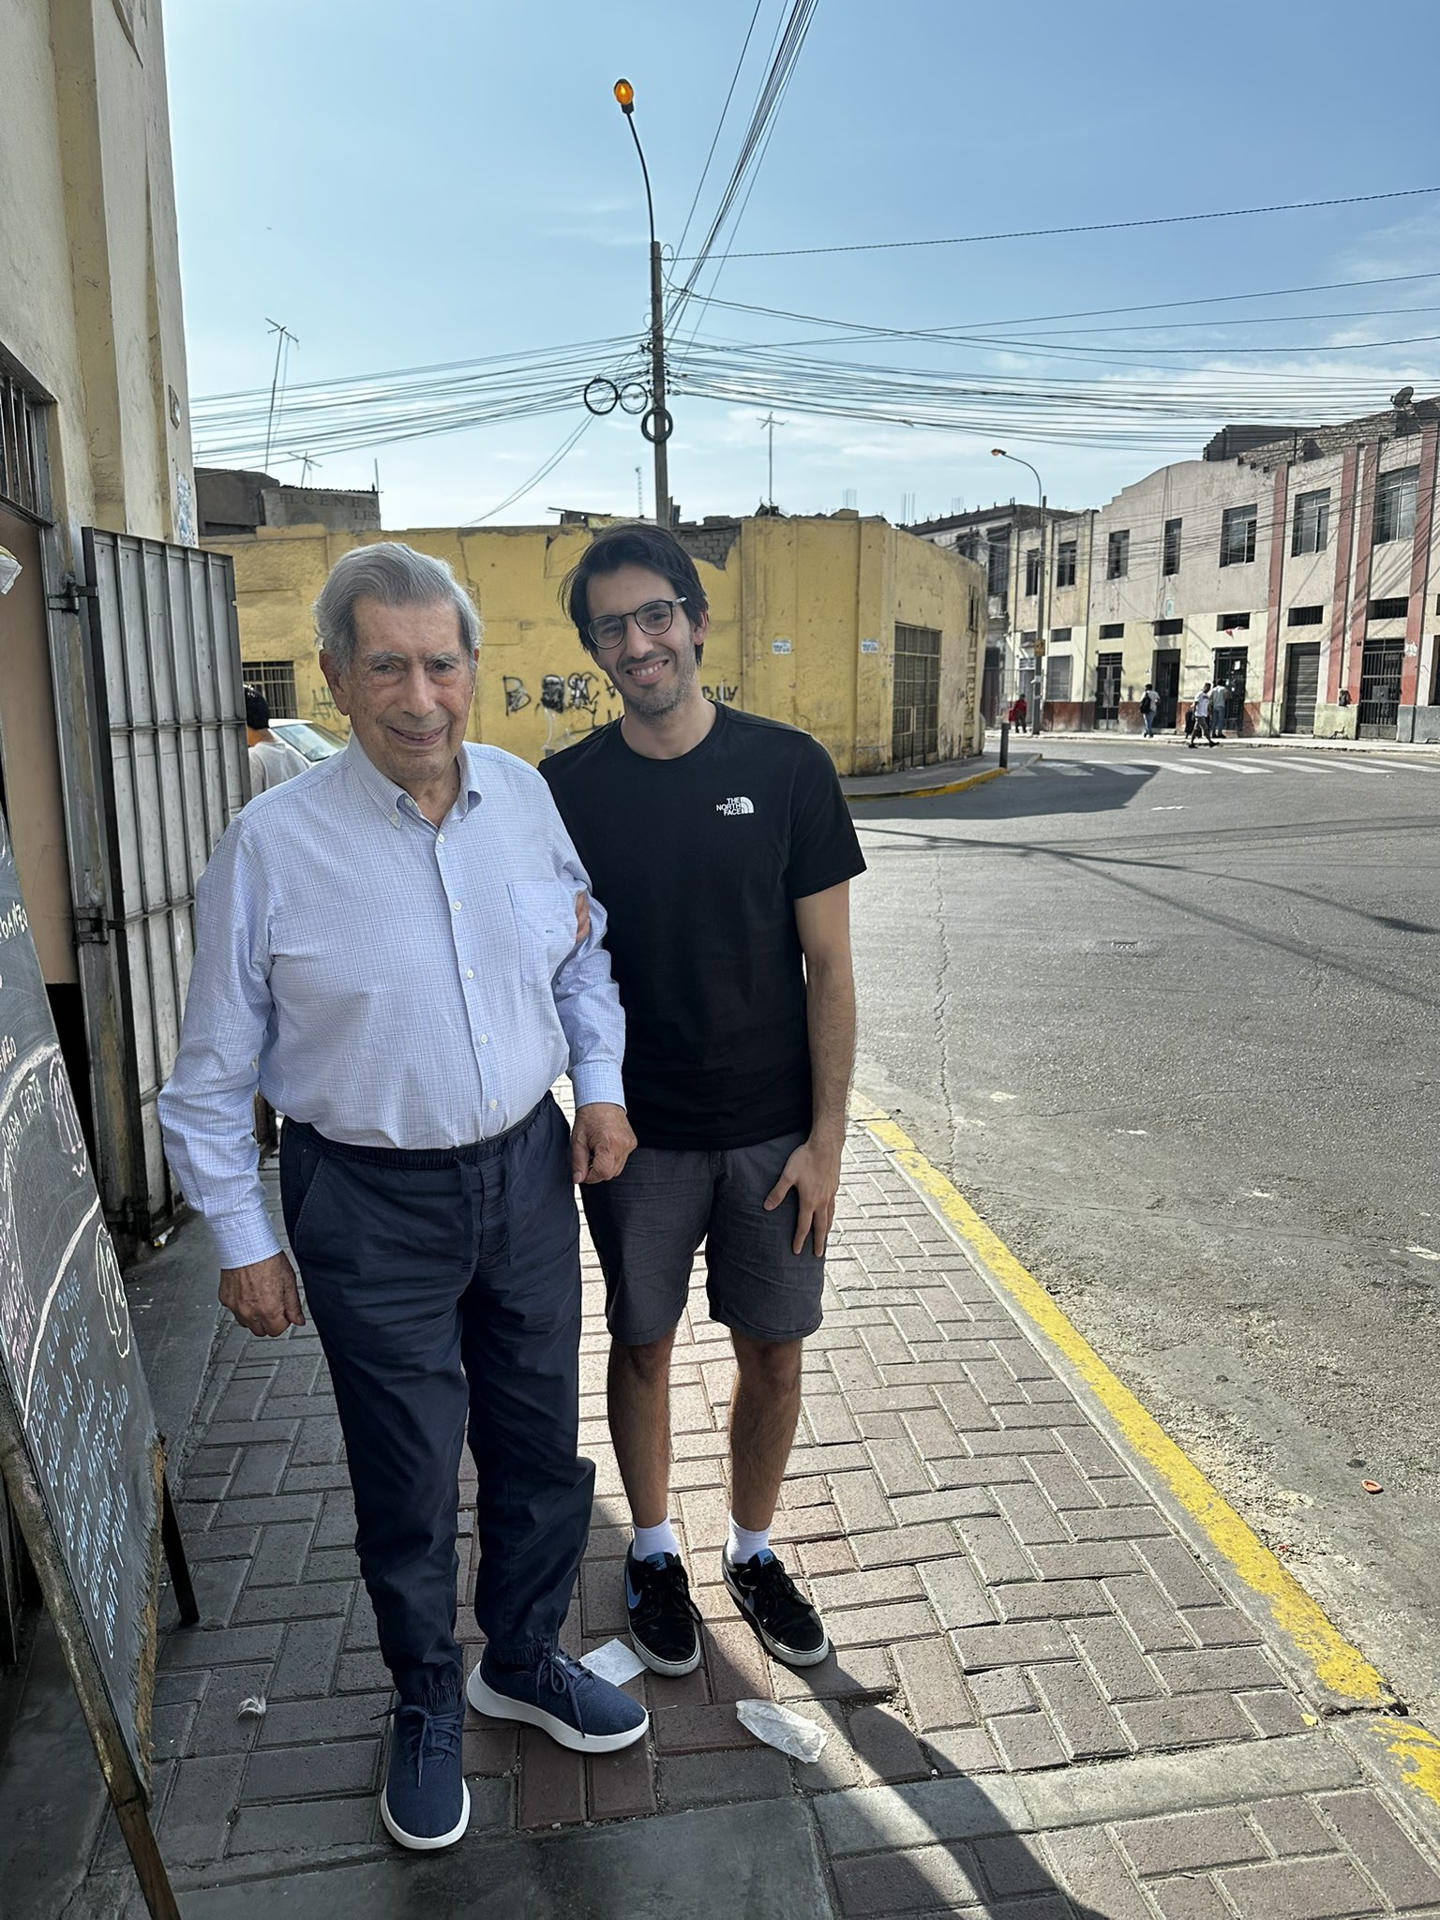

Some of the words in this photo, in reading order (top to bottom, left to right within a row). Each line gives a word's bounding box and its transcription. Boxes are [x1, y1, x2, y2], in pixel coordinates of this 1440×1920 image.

[726, 796, 741, 804] THE
[716, 802, 741, 811] NORTH
[723, 808, 742, 816] FACE
[87, 1379, 113, 1498] MARISCOS
